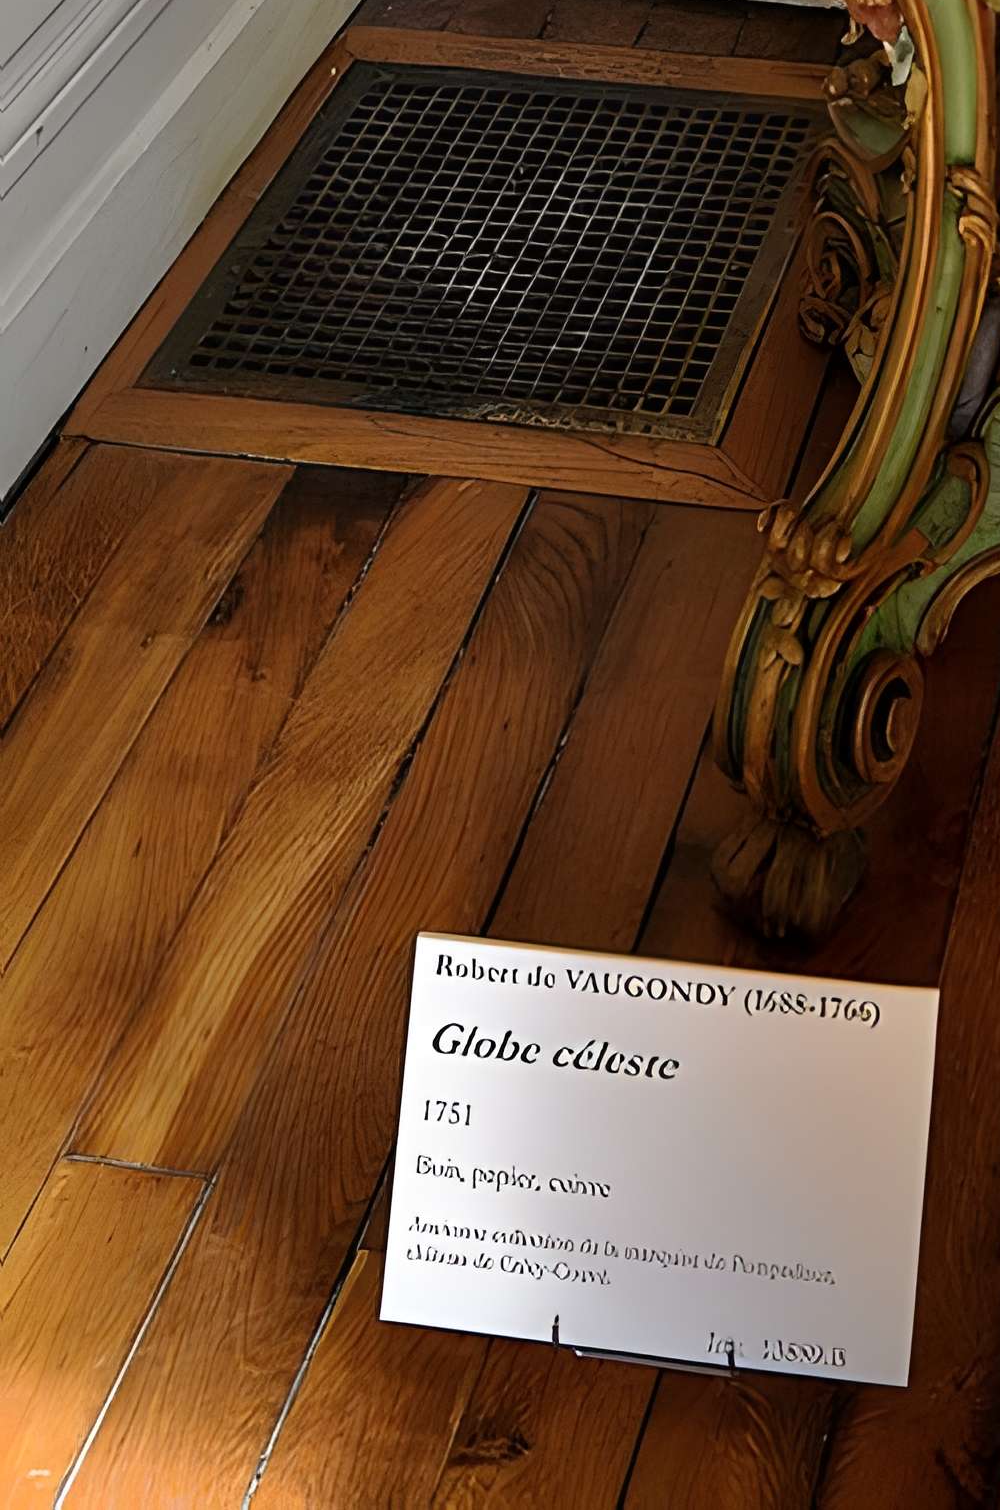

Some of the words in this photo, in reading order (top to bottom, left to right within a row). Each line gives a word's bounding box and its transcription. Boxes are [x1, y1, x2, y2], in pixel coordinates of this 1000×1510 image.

[436, 953, 519, 984] Robert
[527, 965, 556, 988] de
[566, 969, 736, 1006] VAUGONDY
[432, 1022, 541, 1064] Globe
[552, 1039, 680, 1080] céleste
[423, 1099, 472, 1126] 1751
